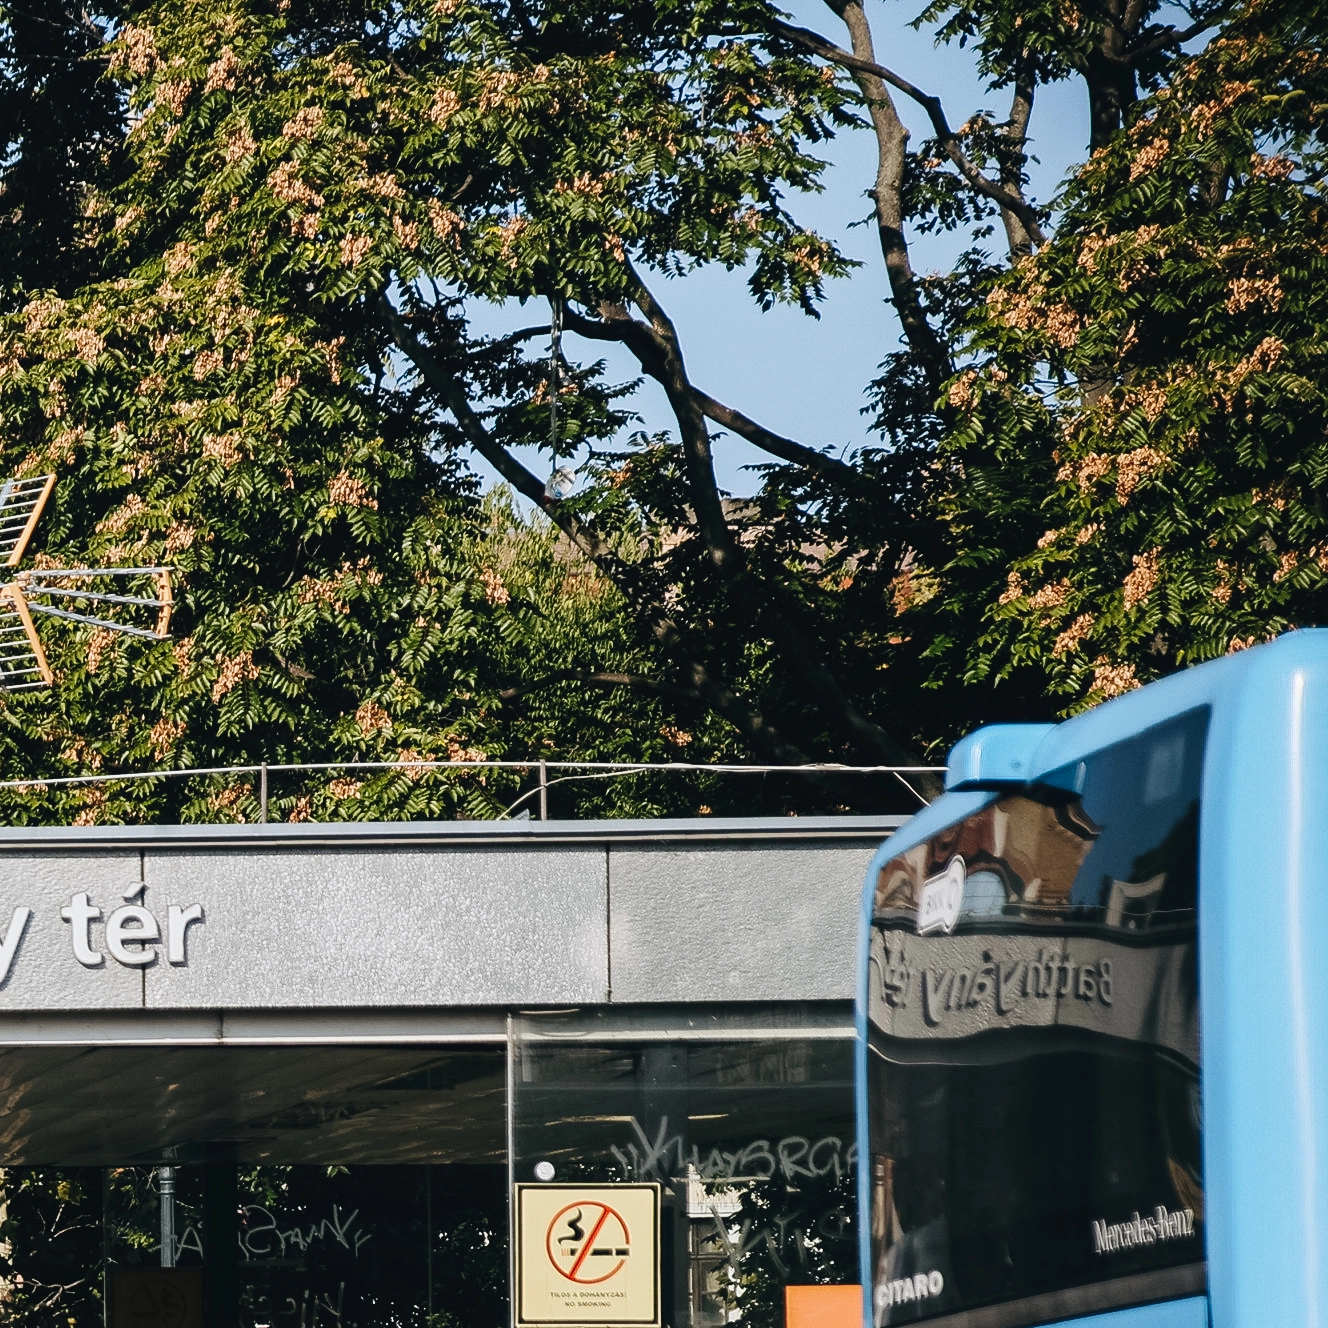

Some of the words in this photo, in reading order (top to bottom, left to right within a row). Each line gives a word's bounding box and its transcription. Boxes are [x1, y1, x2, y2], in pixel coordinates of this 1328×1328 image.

[60, 881, 206, 974] tér
[1093, 1204, 1195, 1255] Mercedes-Benz
[876, 1270, 945, 1308] CITARO
